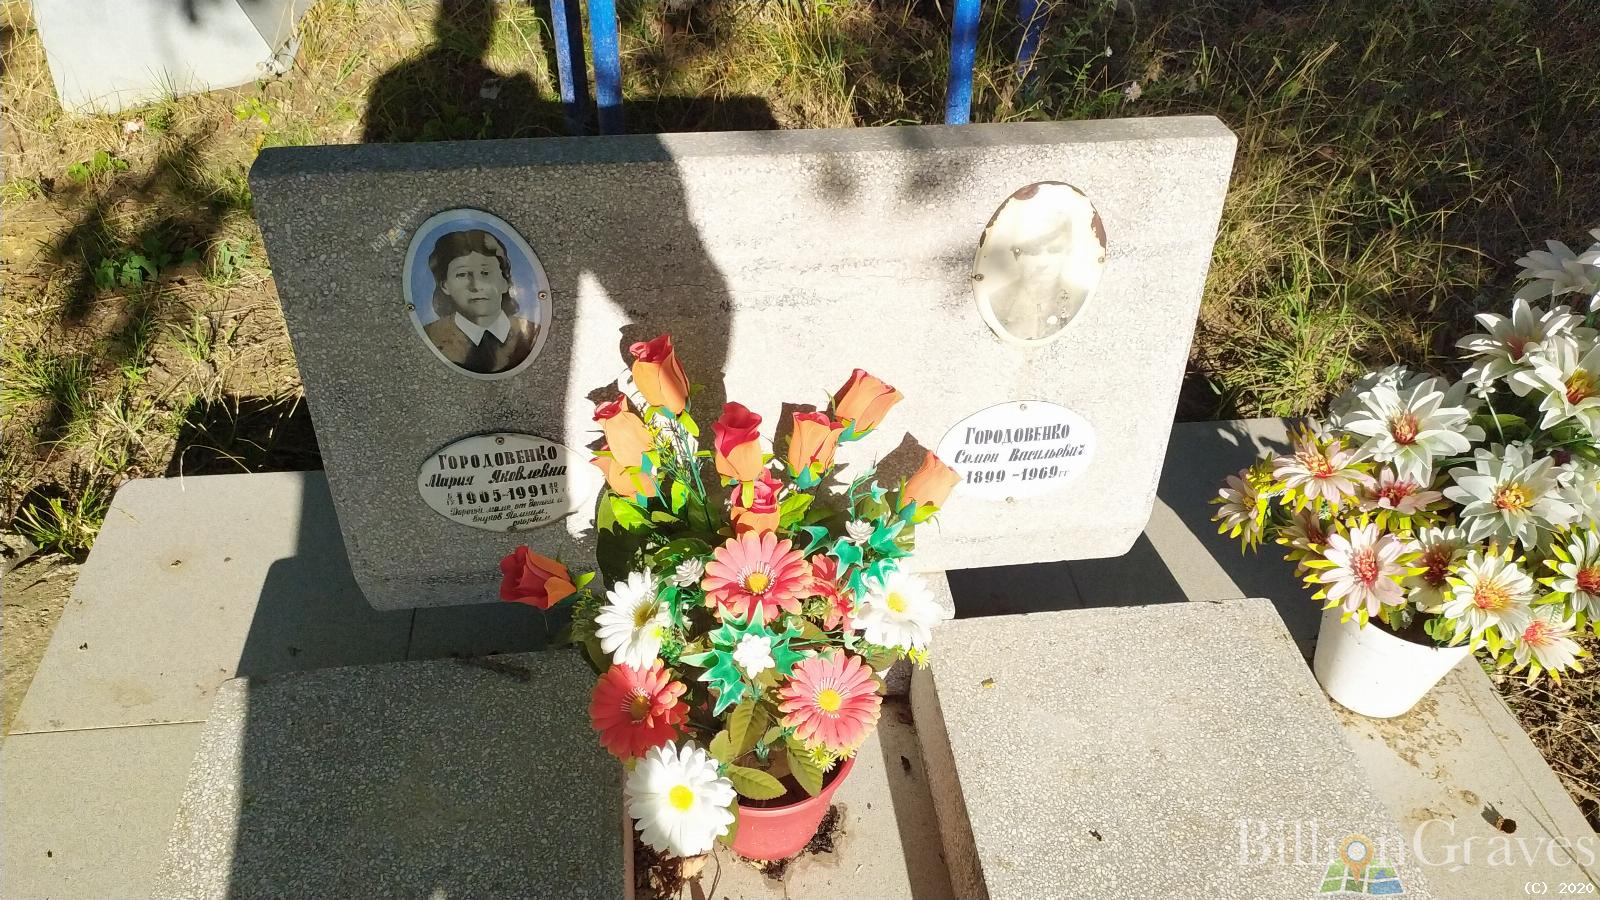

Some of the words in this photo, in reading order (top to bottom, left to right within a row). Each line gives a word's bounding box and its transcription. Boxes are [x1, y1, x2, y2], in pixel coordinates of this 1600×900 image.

[965, 424, 1070, 445] ГОРОДОВЕНКО
[438, 446, 558, 470] ГОРОДОВЕНКО
[1008, 443, 1085, 461] Васильевич
[425, 474, 475, 489] Мария
[488, 463, 568, 484] Яковлевна
[966, 470, 1006, 484] 1899
